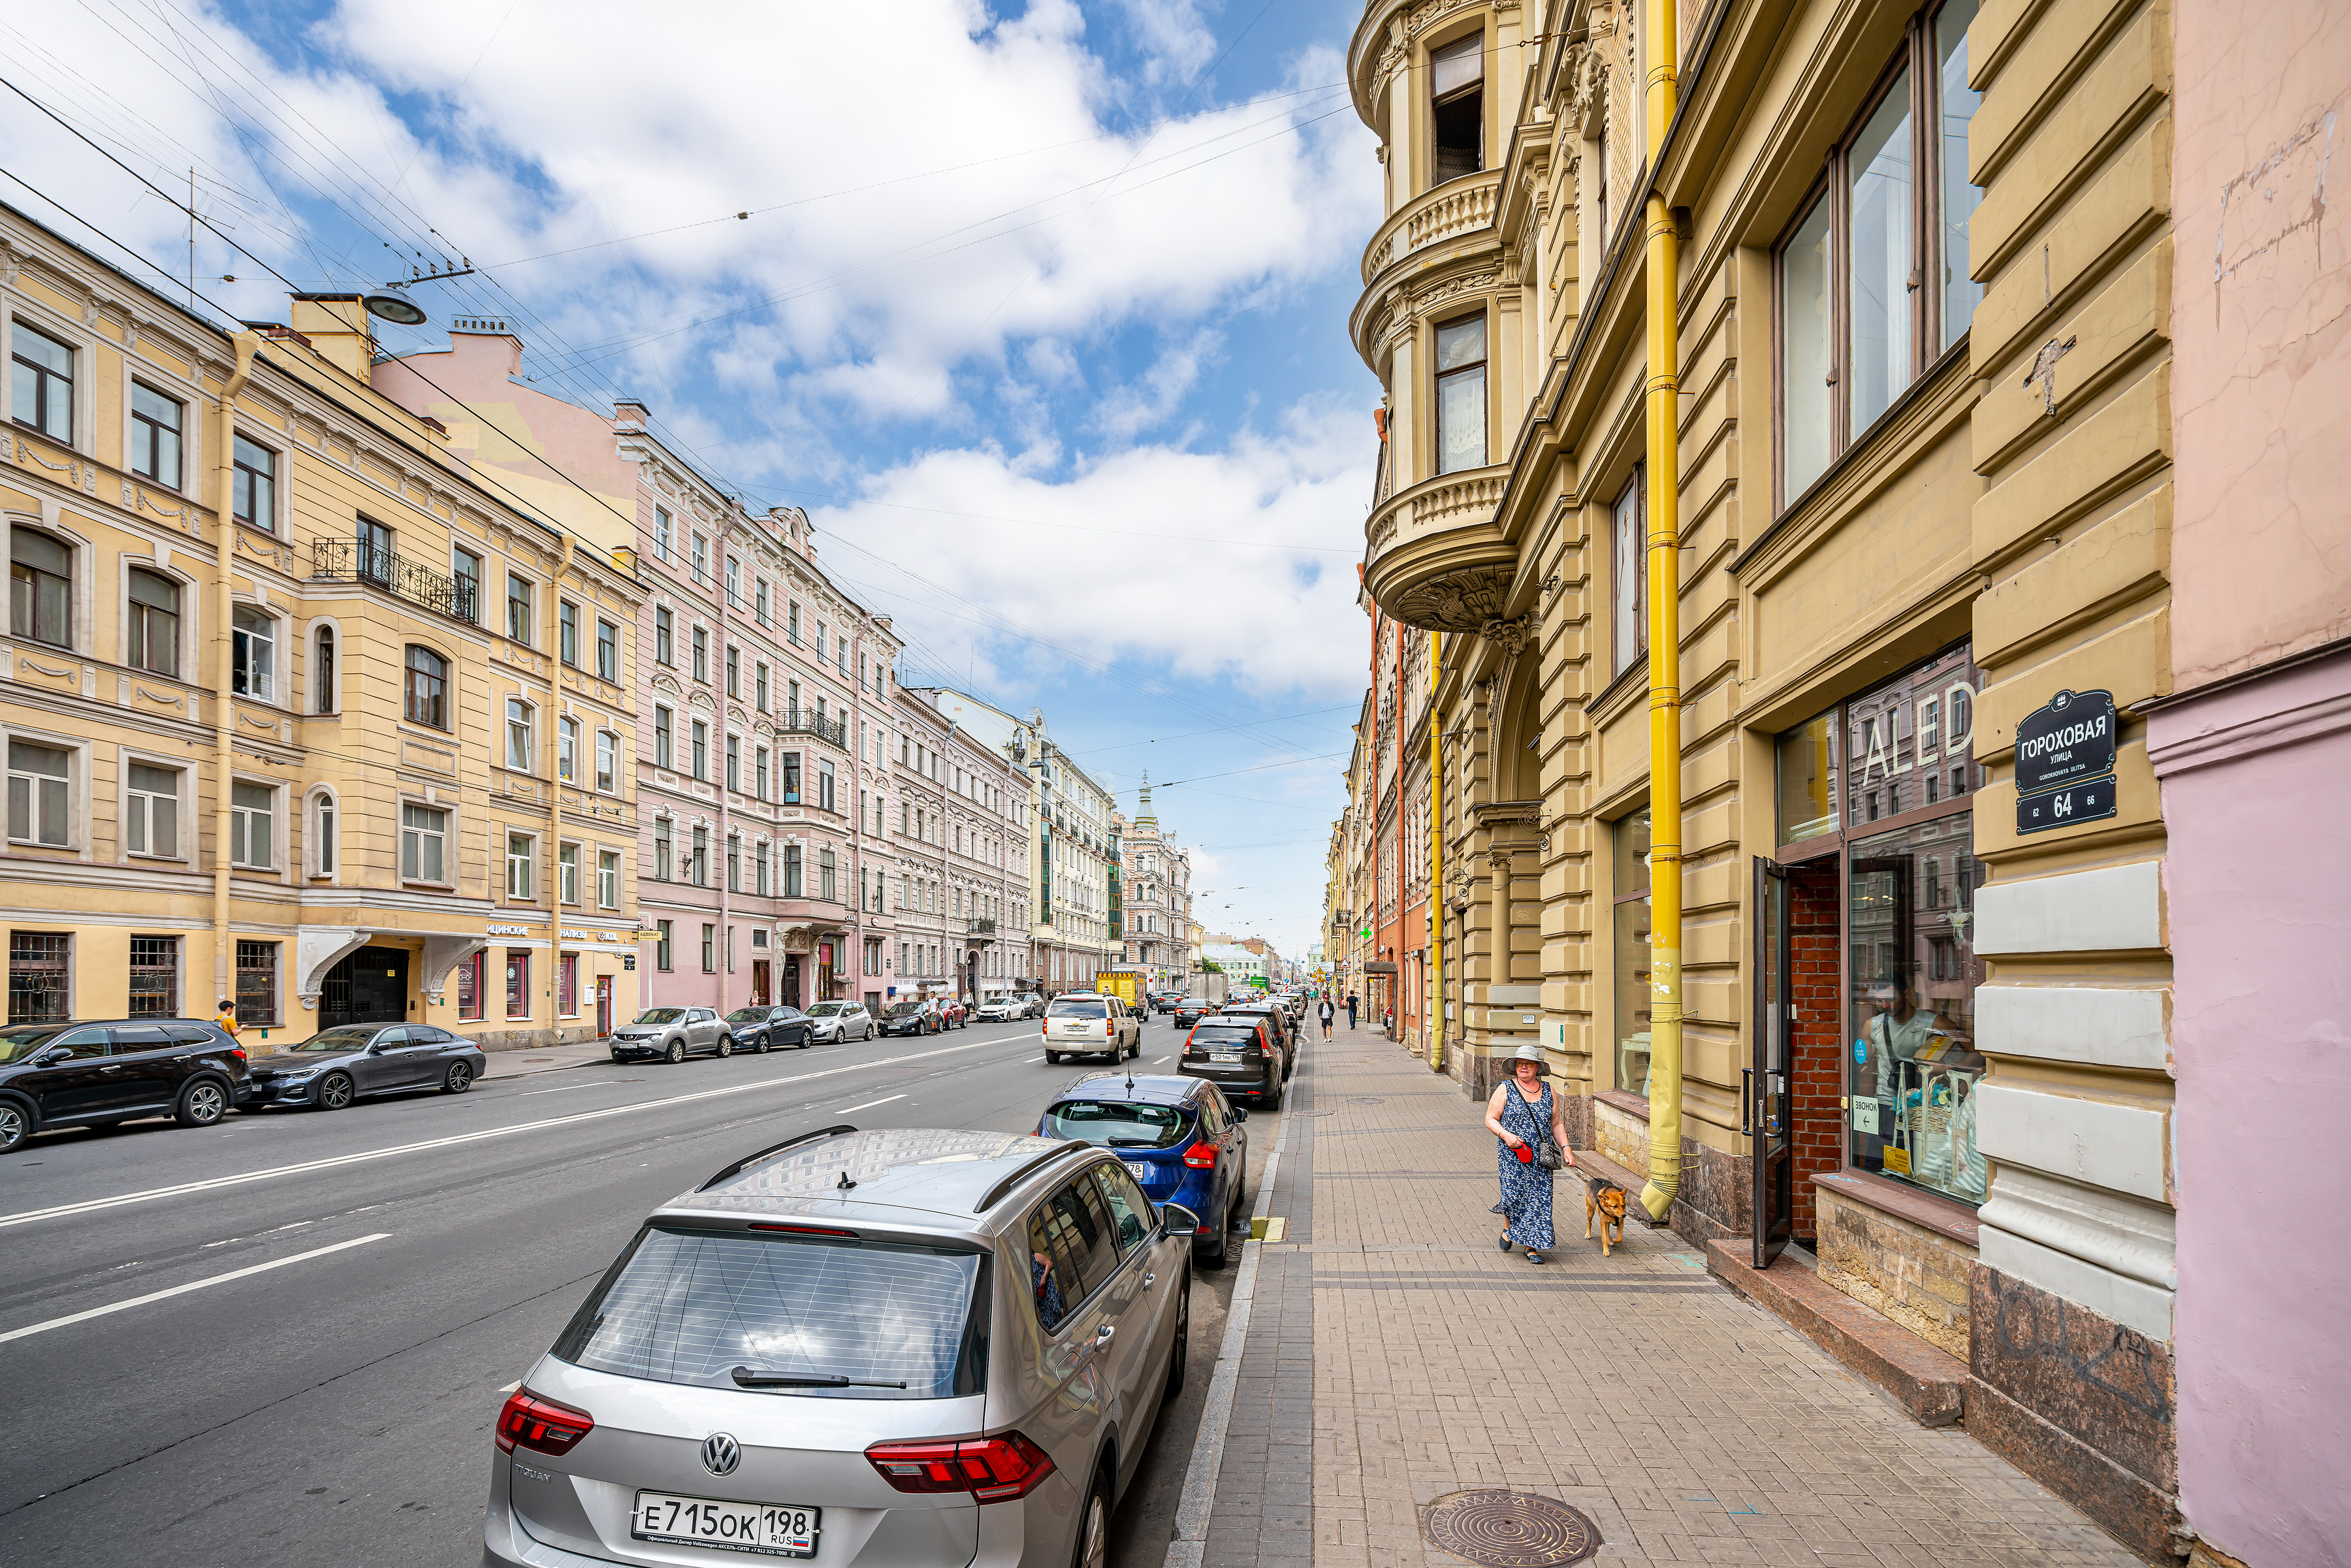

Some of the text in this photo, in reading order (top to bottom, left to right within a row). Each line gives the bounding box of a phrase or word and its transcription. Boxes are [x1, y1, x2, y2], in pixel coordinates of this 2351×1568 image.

[2021, 715, 2106, 761] ГОРОХОВАЯ
[2050, 750, 2072, 765] УЛИЦА
[2039, 763, 2086, 781] GOROKHOVAYA ULITSA
[2032, 792, 2095, 818] 62 64 66
[487, 924, 528, 935] ИЦИНСКИЕ
[605, 932, 618, 940] KDL
[1855, 1100, 1878, 1112] ЗВОНОК
[515, 1464, 551, 1484] TIGUAN
[644, 1500, 807, 1541] Е715ОК 198
[647, 1536, 678, 1544] Официальный
[718, 1544, 750, 1552] АКСЕЛЬ-СИТИ
[771, 1535, 792, 1545] RUS
